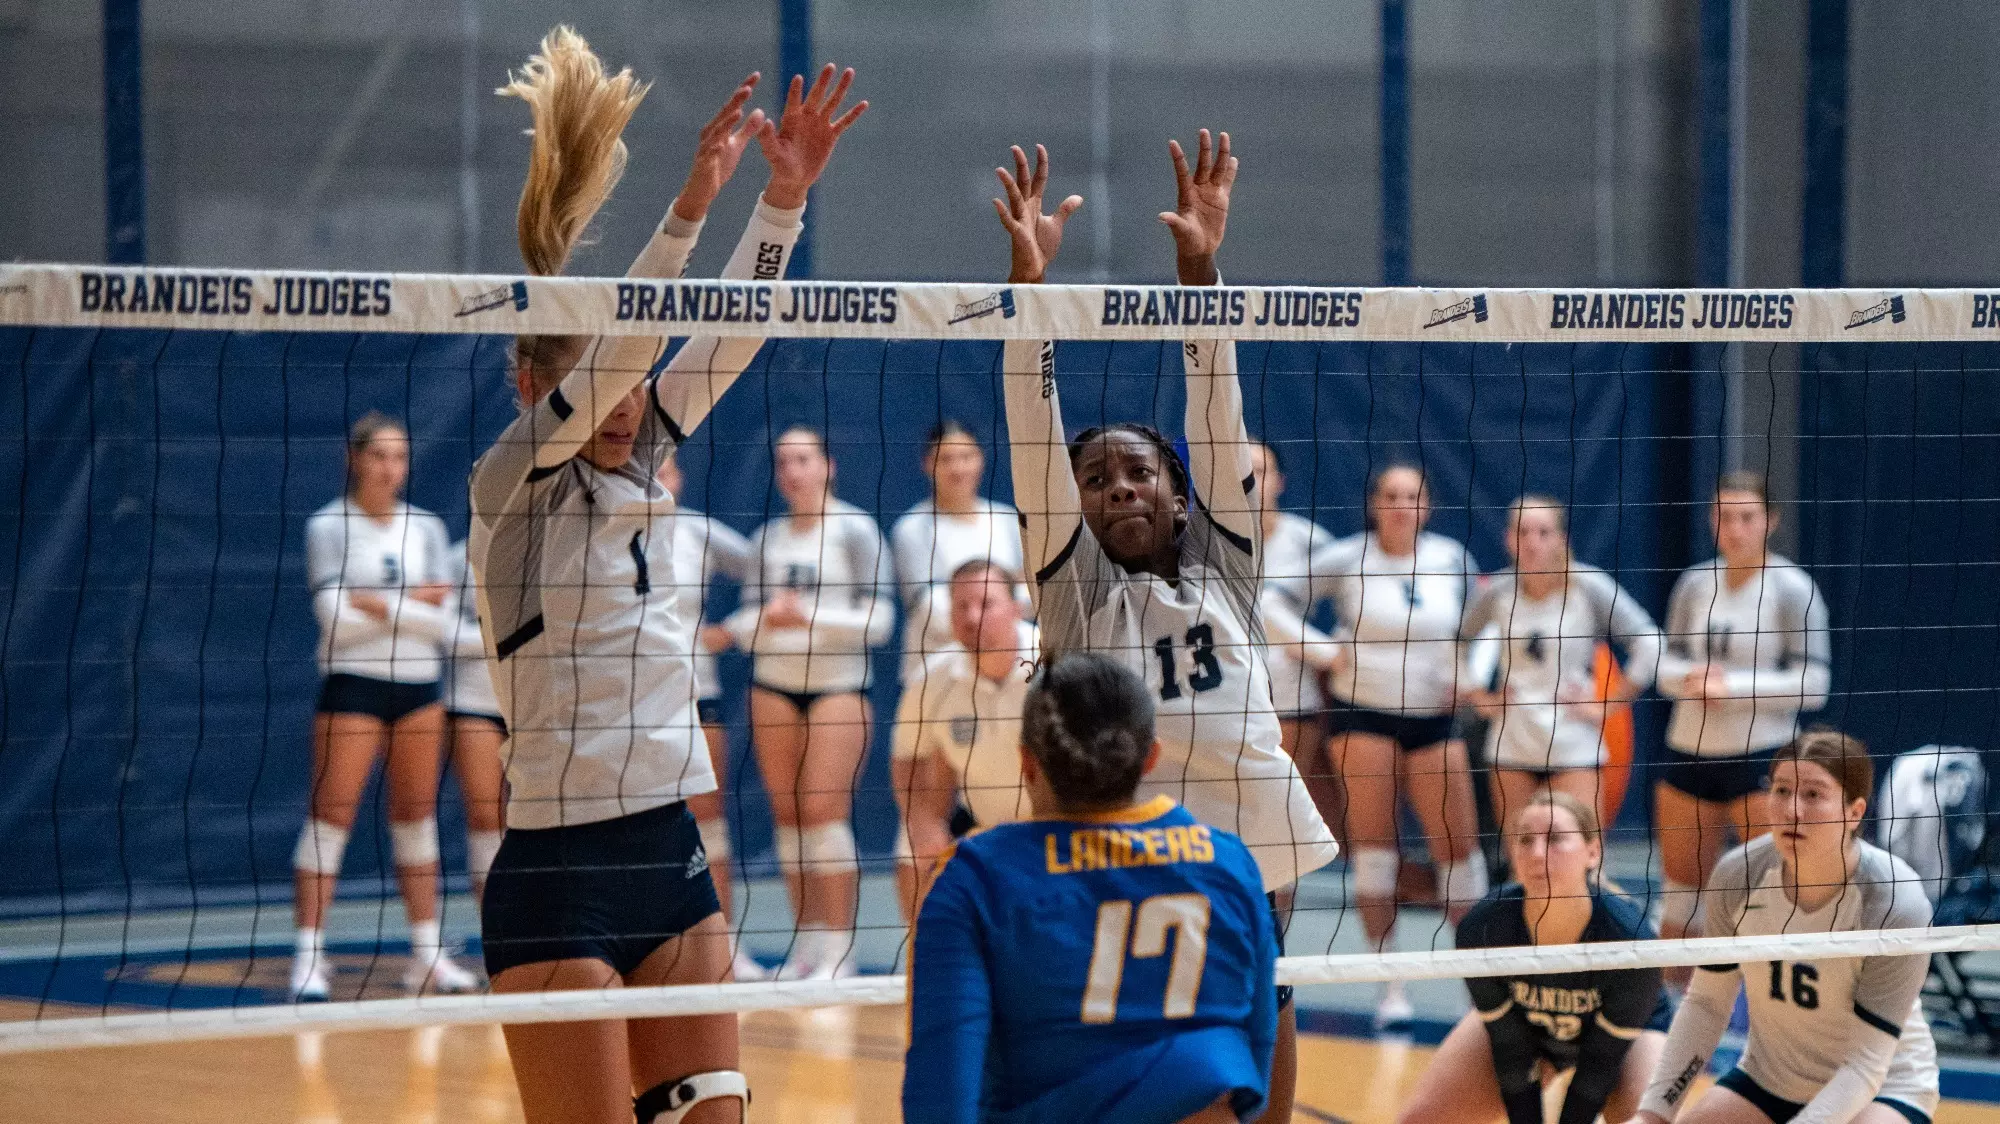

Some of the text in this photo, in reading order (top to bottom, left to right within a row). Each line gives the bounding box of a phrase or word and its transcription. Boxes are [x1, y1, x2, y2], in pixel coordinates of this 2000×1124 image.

[80, 273, 391, 316] BRANDEIS JUDGES
[616, 283, 897, 324] BRANDEIS JUDGES
[1102, 289, 1362, 327] BRANDEIS JUDGES
[1551, 294, 1795, 329] BRANDEIS JUDGES
[629, 528, 651, 596] 1
[1155, 623, 1222, 701] 13
[1044, 824, 1215, 875] LANCERS
[1081, 893, 1212, 1025] 17
[1769, 960, 1819, 1010] 16
